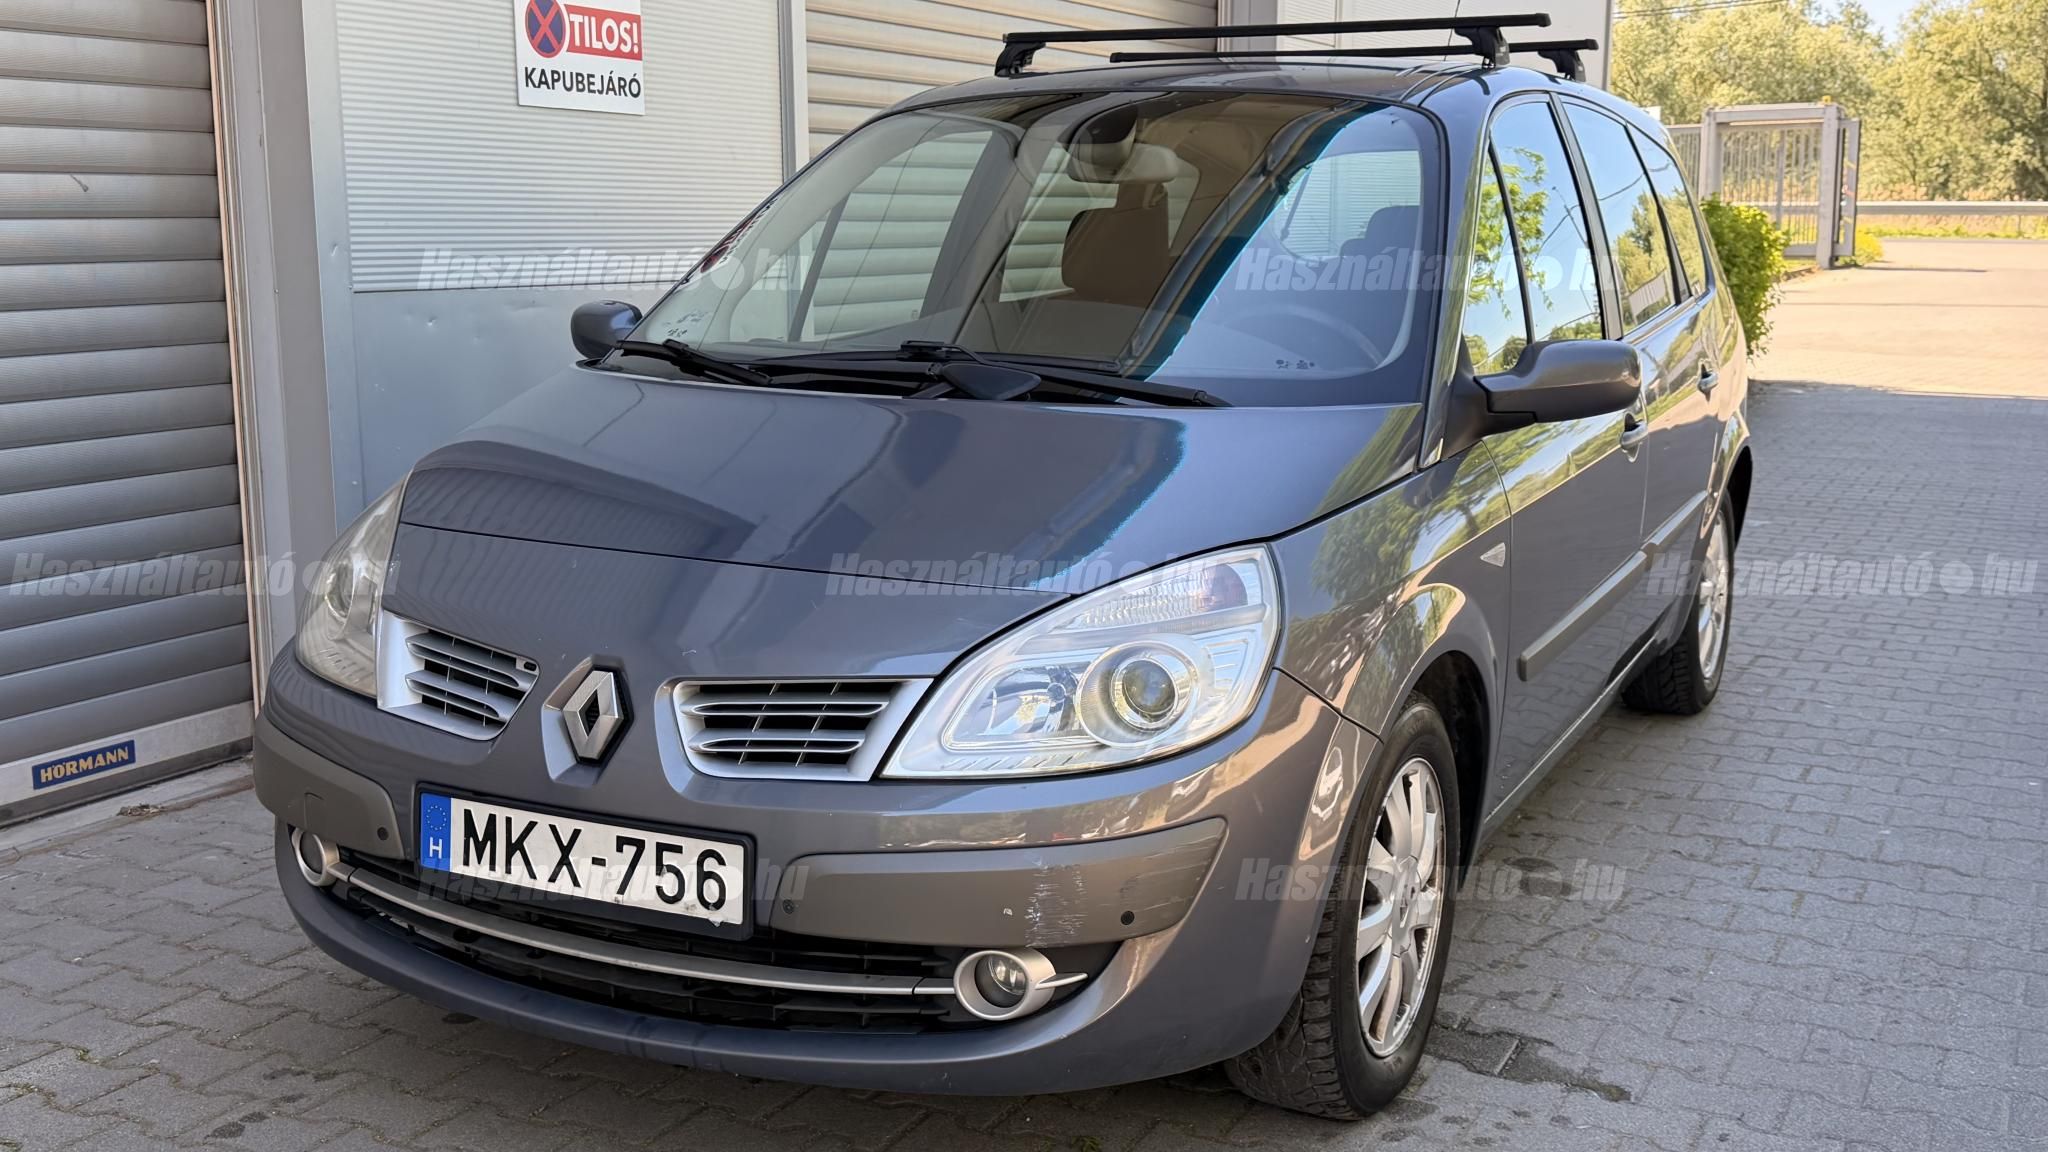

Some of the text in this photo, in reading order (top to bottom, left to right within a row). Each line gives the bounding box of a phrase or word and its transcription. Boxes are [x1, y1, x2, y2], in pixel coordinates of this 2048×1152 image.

[568, 13, 639, 54] TILOS!
[524, 66, 641, 98] KAPUBEJÁRÓ
[40, 746, 129, 783] HÖRMANN
[429, 808, 727, 911] H MKX-756
